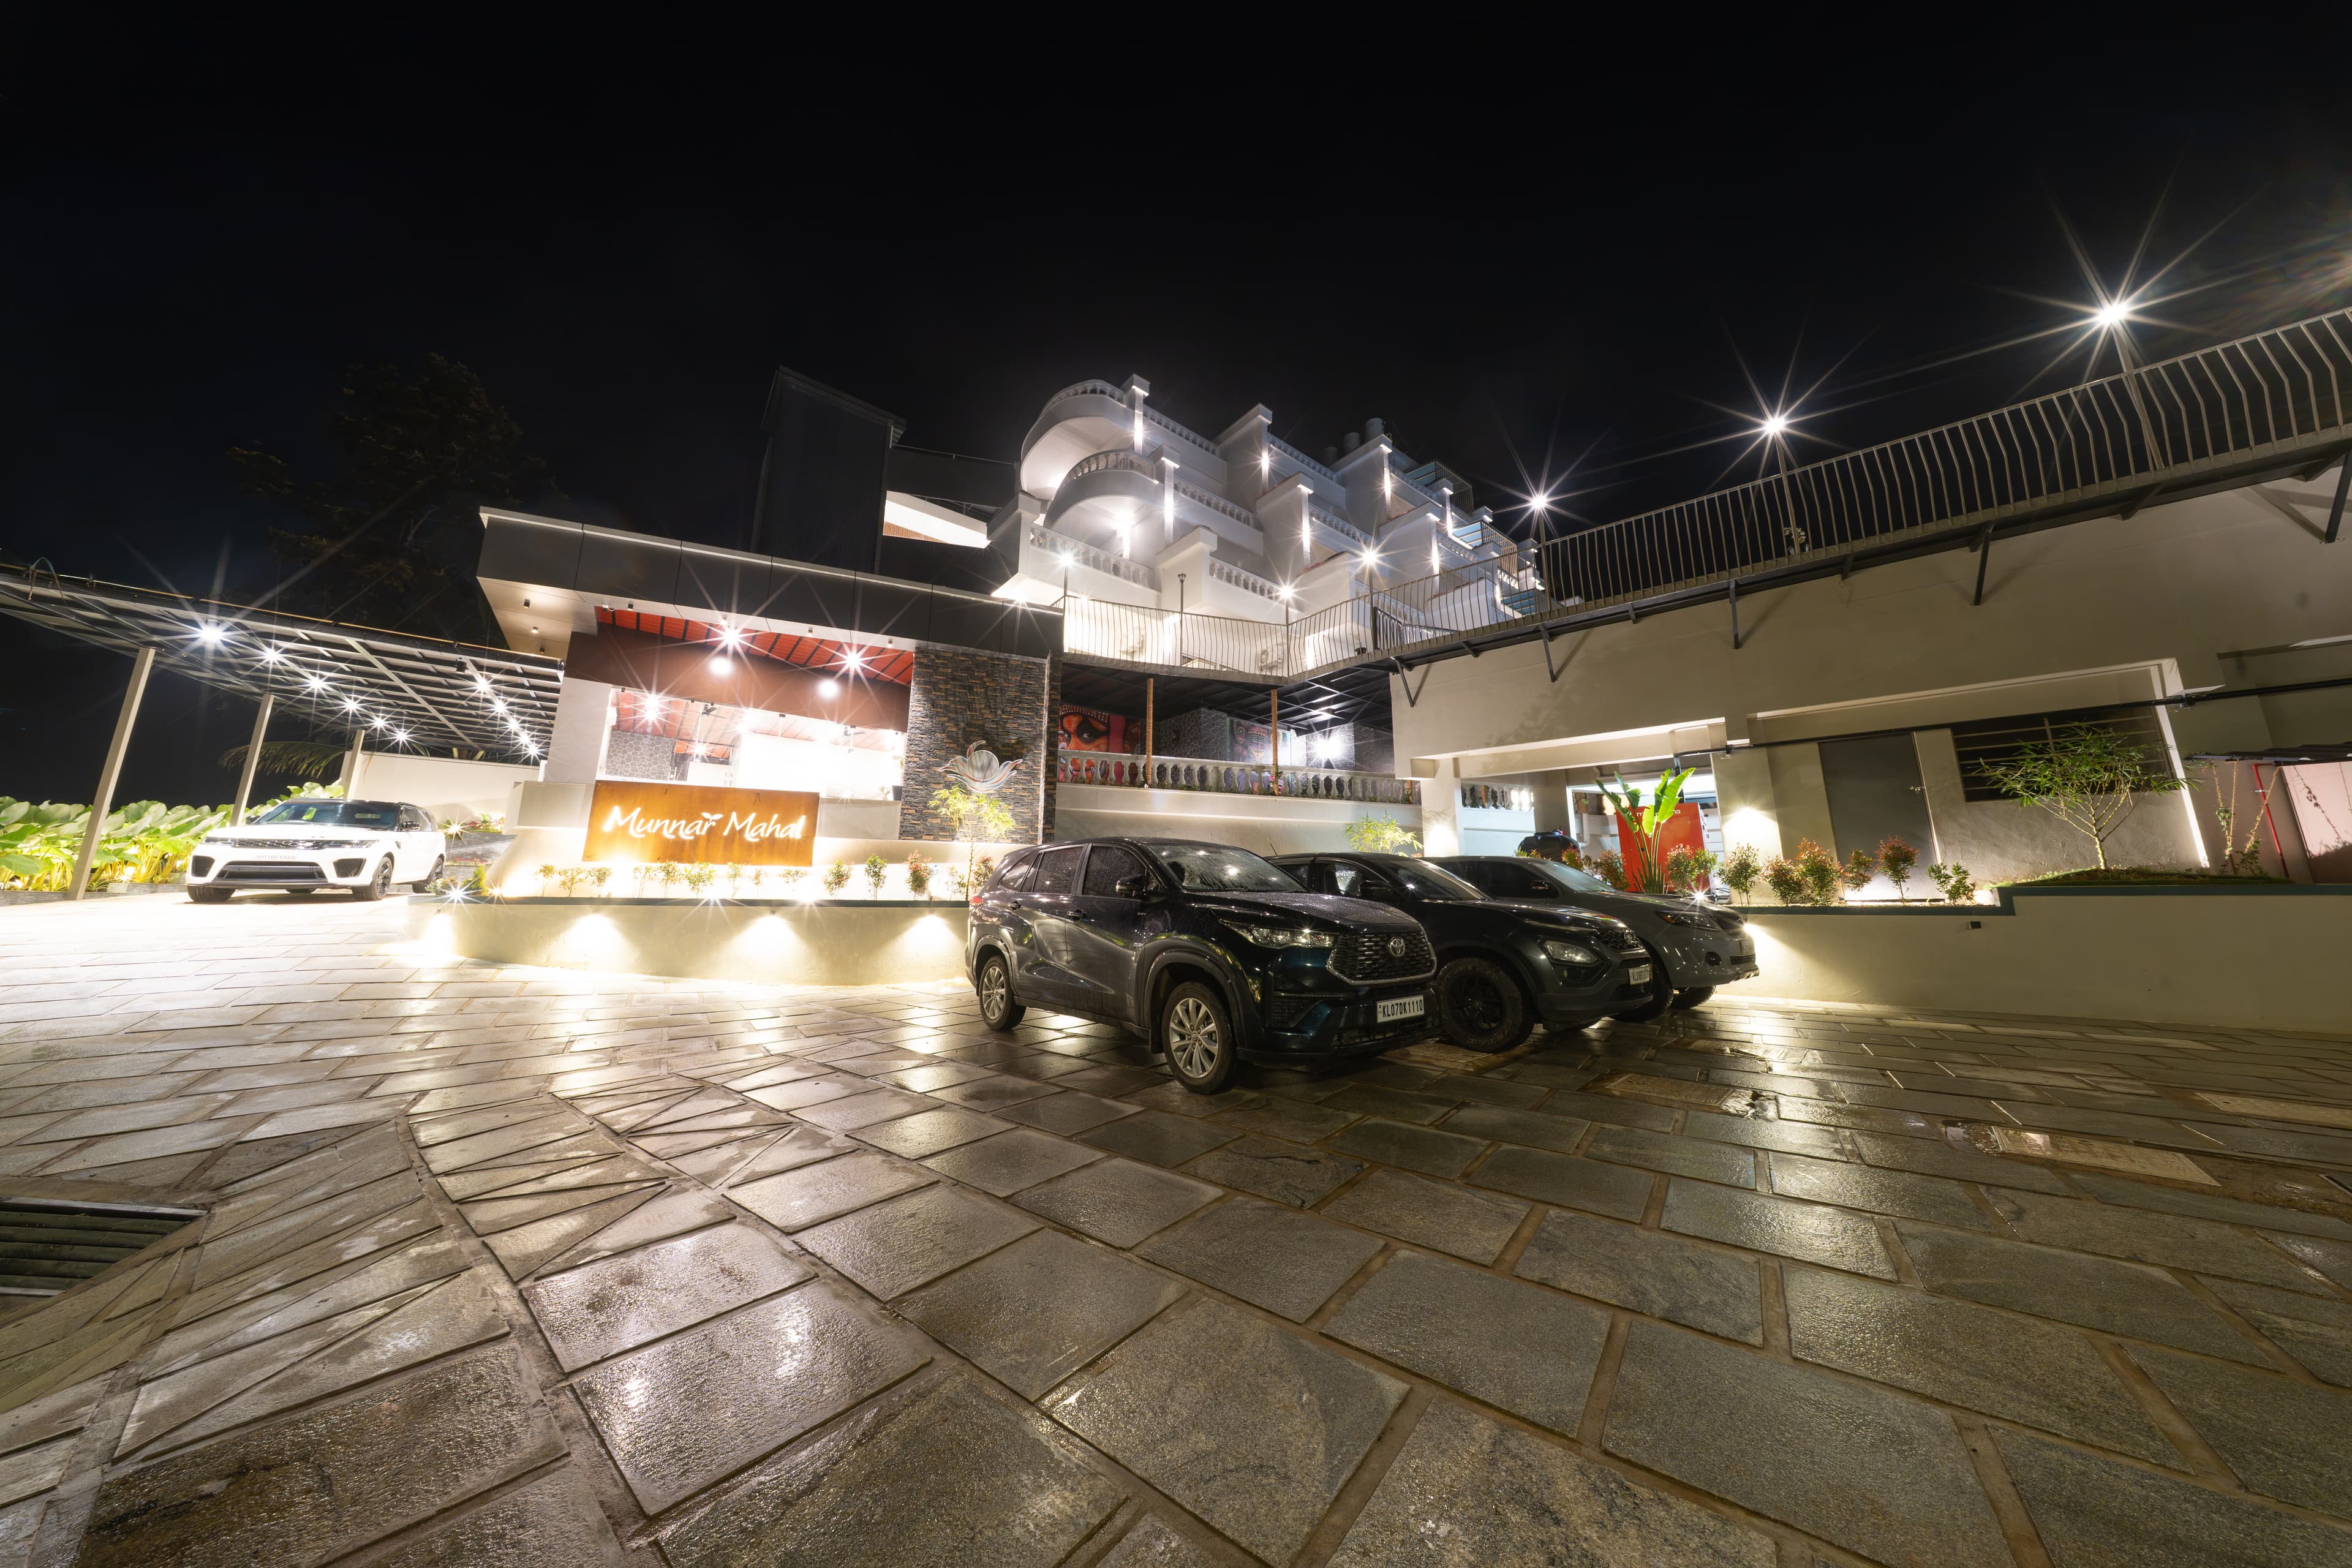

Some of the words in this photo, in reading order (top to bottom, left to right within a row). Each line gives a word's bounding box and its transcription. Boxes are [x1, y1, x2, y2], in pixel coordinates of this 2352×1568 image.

[603, 805, 718, 840] Munnar
[723, 812, 806, 842] Mahal
[1382, 999, 1423, 1018] KL07DK1110
